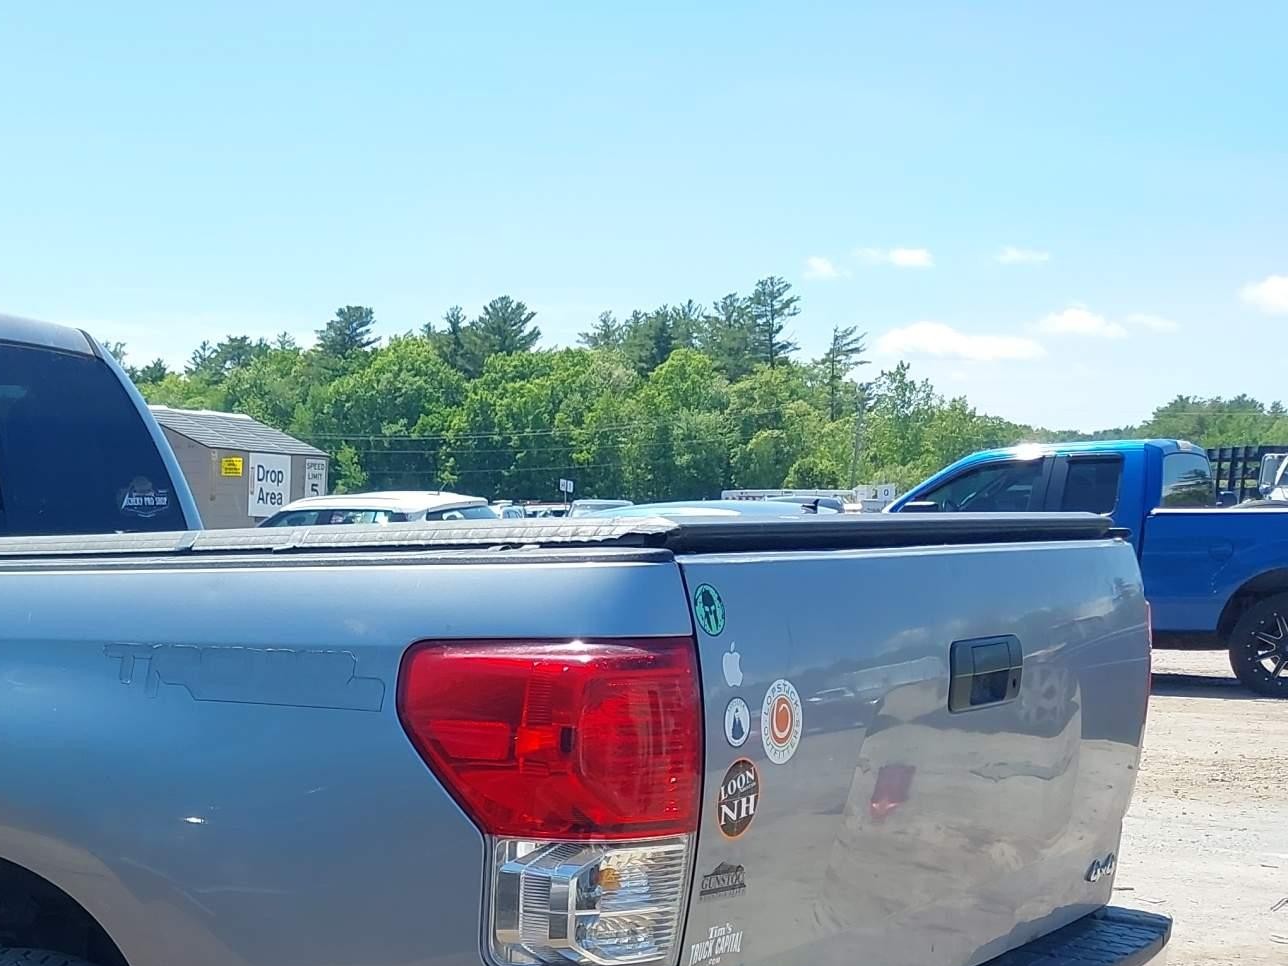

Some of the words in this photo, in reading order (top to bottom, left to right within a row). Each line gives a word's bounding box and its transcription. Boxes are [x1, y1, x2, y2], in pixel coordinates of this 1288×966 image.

[257, 464, 284, 486] Drop
[306, 462, 325, 471] SPEED
[256, 487, 283, 506] Area
[311, 483, 319, 497] 5
[763, 682, 800, 717] LOPSTICK
[720, 766, 755, 802] LOON
[720, 793, 758, 826] NH
[708, 922, 733, 940] Tim's
[715, 930, 743, 955] CAPITAL
